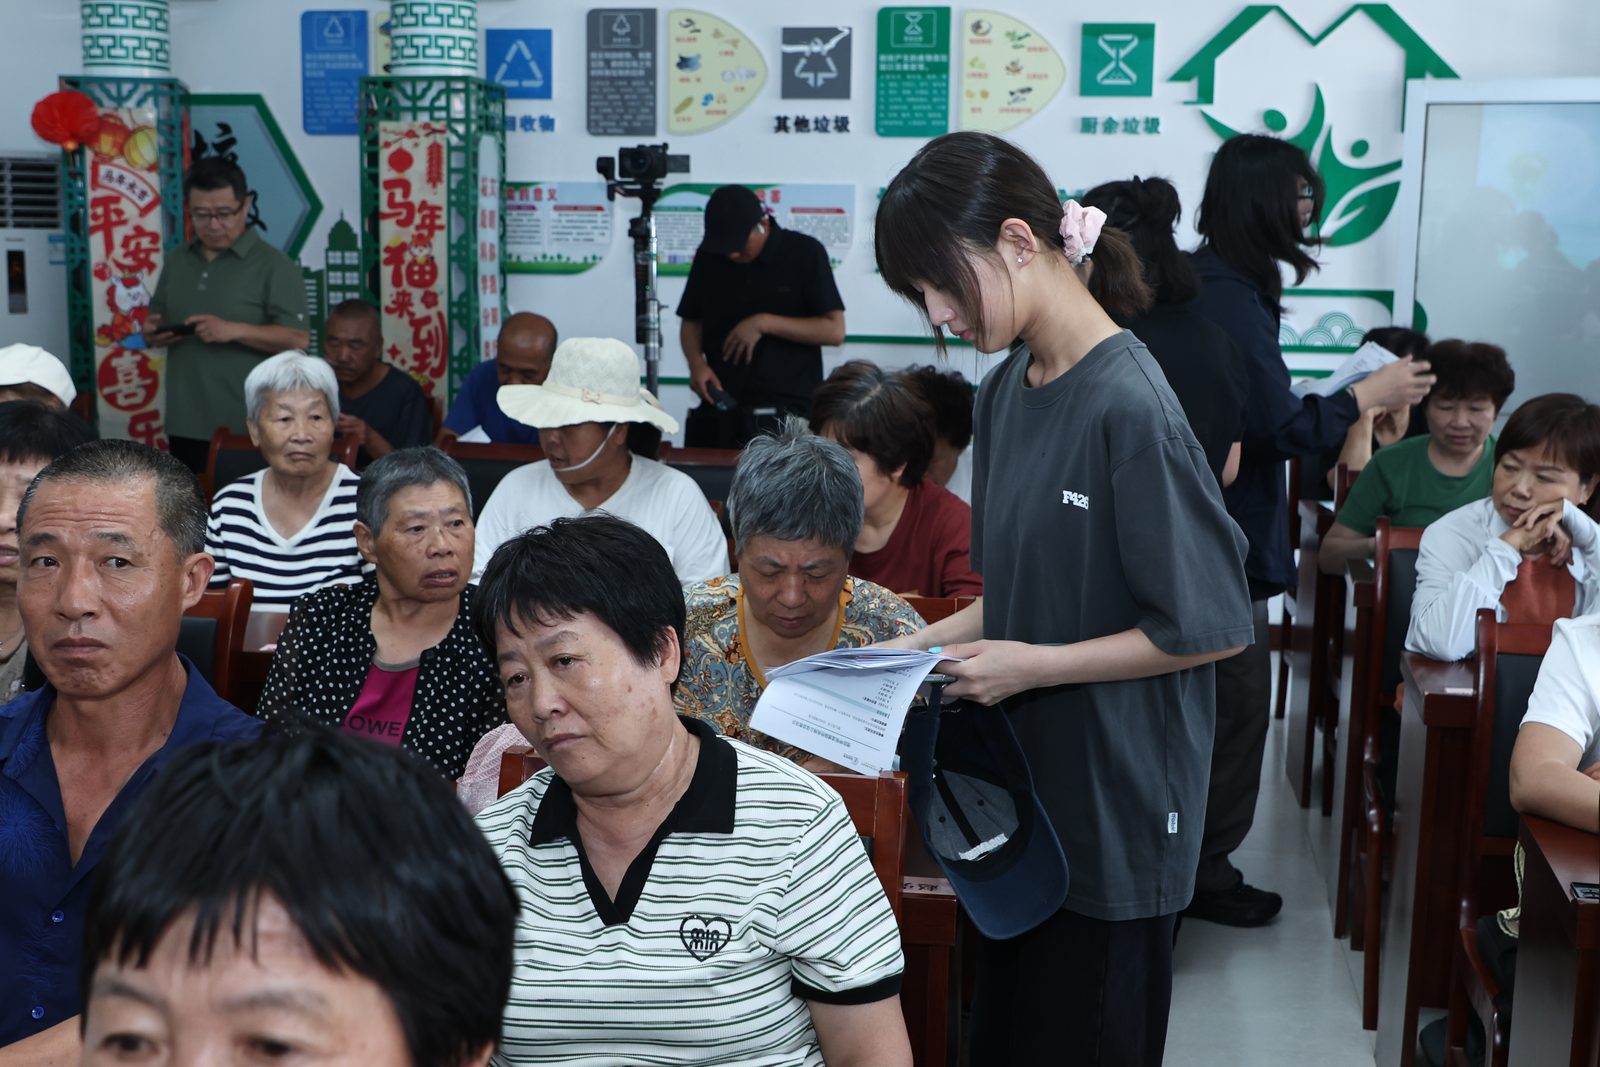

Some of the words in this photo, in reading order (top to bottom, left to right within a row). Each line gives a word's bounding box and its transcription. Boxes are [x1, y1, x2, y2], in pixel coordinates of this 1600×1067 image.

[491, 114, 555, 132] 回收物
[774, 115, 850, 134] 其他垃圾
[1080, 116, 1160, 134] 厨余垃圾
